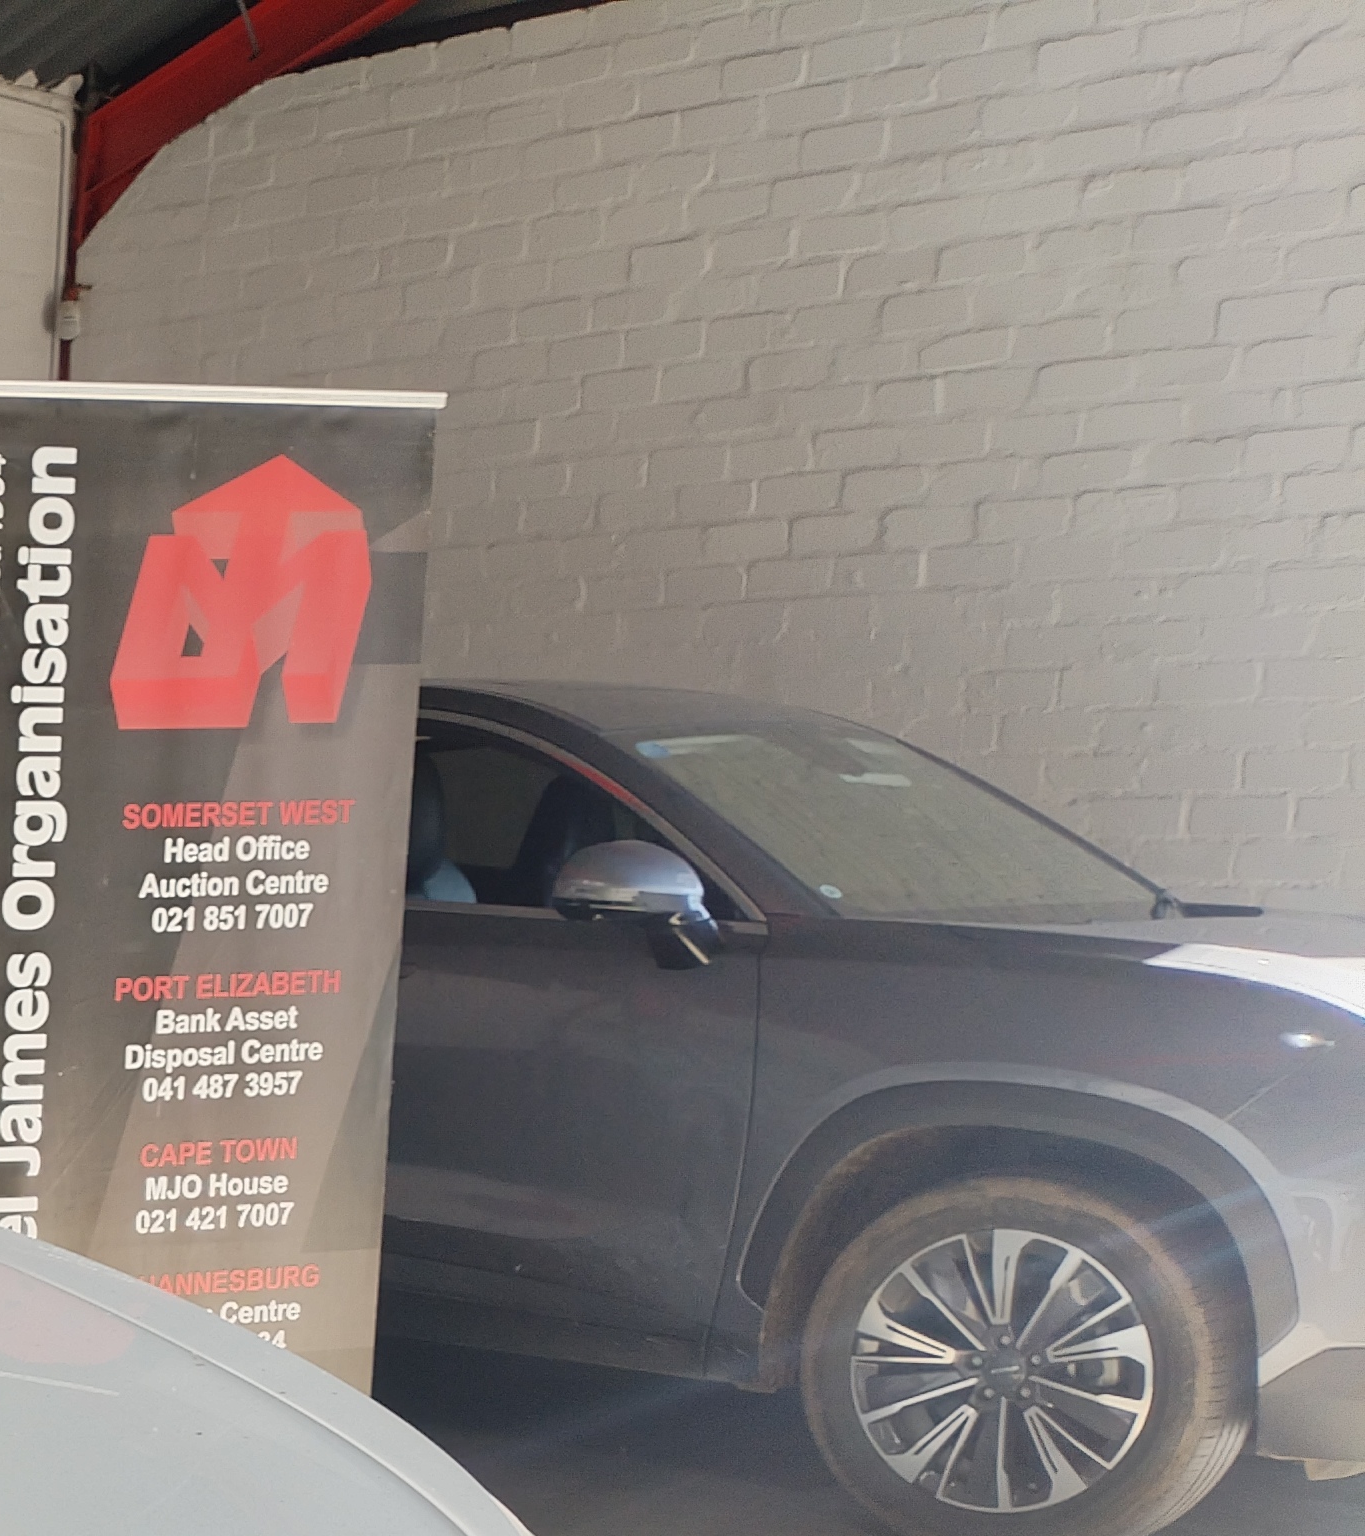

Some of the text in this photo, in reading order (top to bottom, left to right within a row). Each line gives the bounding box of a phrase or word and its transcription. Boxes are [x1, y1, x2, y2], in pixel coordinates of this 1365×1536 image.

[1, 446, 78, 931] Organisation
[122, 799, 355, 830] SOMERSET WEST
[163, 834, 311, 864] Head Office
[138, 870, 330, 900] Auction Centre
[151, 902, 314, 934] 021 851 7007
[114, 969, 342, 1002] PORT ELIZABETH
[155, 1005, 299, 1035] Bank Asset
[124, 1039, 324, 1071] Disposal Centre
[142, 1070, 303, 1103] 041 487 3957
[139, 1137, 299, 1168] CAPE TOWN
[144, 1170, 289, 1202] MJO House
[135, 1201, 295, 1236] 021 421 7007
[138, 1263, 321, 1297] ANNESBURG
[219, 1299, 302, 1325] Centre
